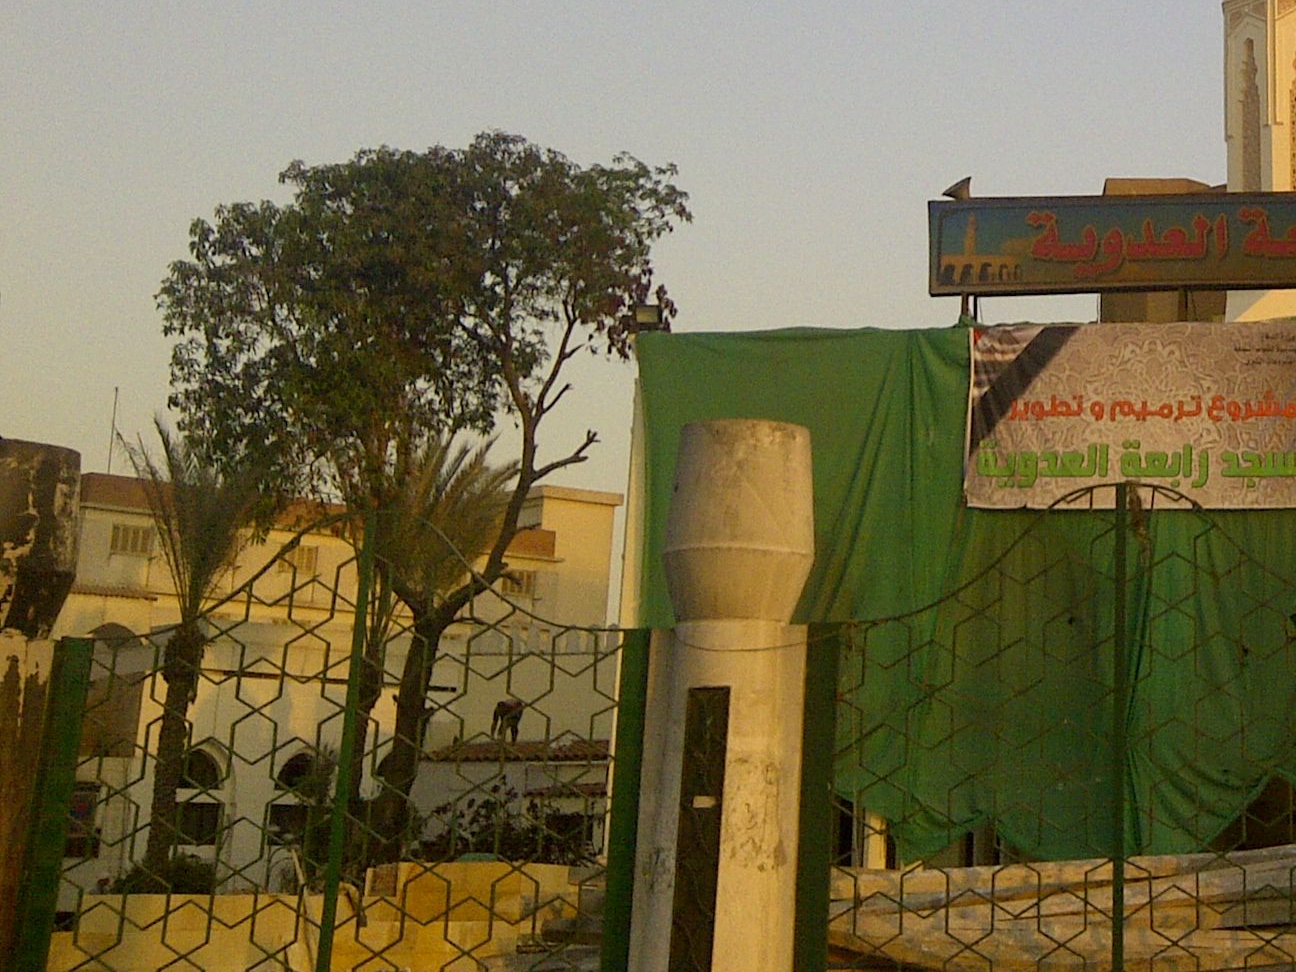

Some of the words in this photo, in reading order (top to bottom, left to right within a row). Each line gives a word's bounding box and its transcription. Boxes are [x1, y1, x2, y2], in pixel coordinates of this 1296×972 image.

[1025, 210, 1229, 277] العدوية
[1007, 394, 1084, 422] تطوير
[1089, 398, 1104, 421] و
[1110, 393, 1202, 422] ترميم
[976, 439, 1110, 489] العدوية
[1120, 439, 1210, 488] رابعة
